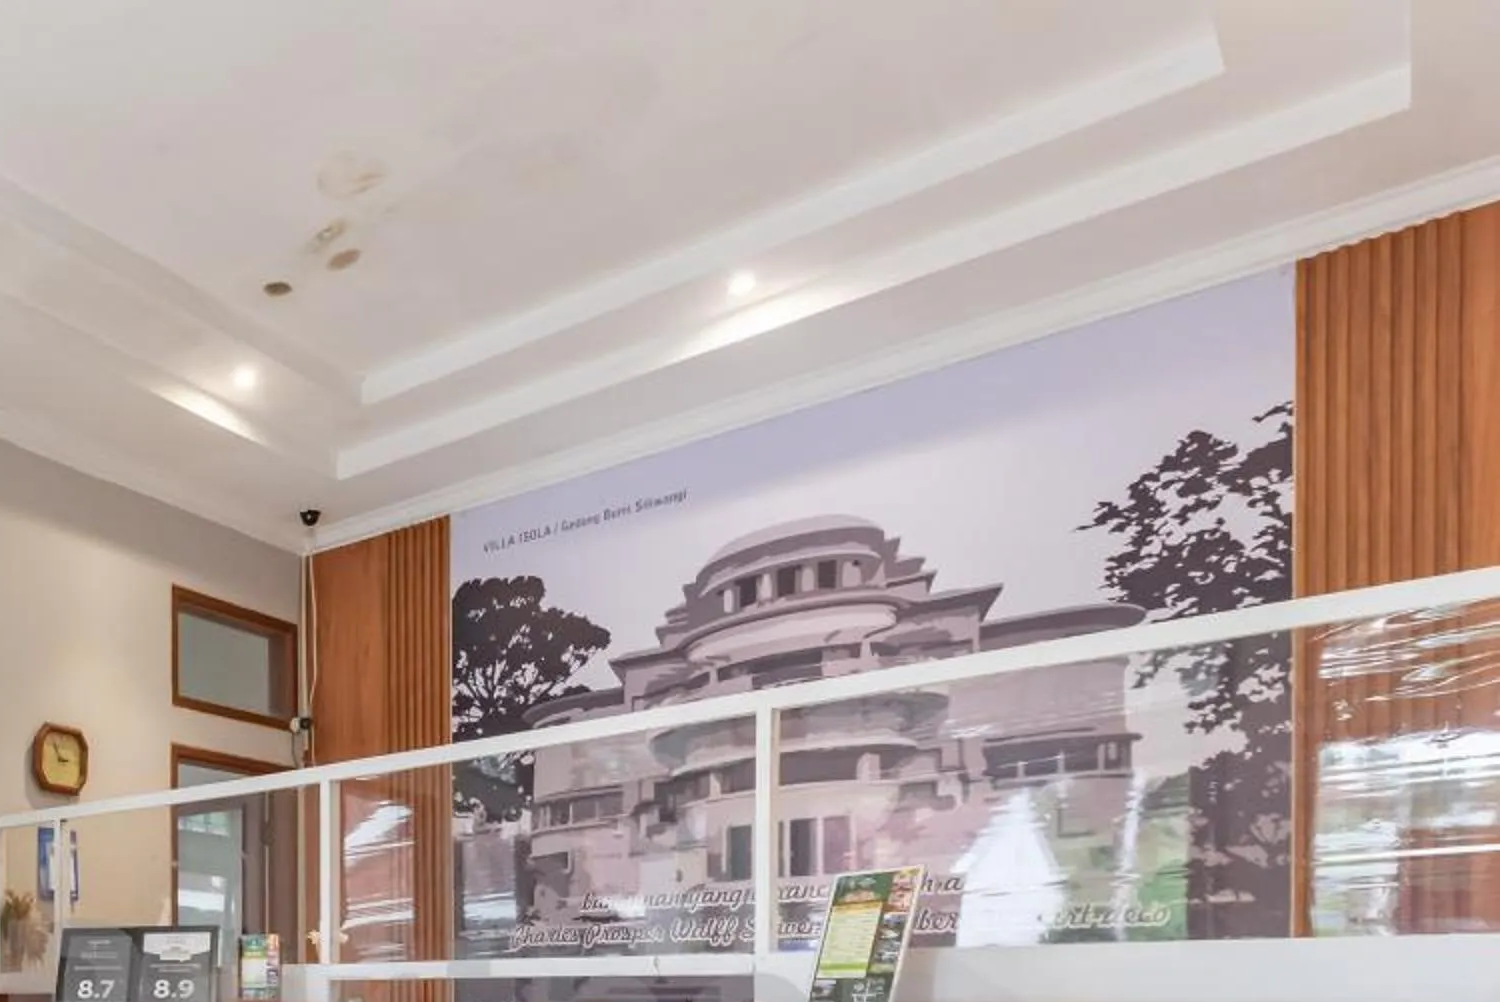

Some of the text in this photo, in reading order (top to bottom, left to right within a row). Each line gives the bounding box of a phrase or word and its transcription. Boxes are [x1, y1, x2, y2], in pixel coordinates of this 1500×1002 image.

[519, 526, 551, 544] ISOLA
[77, 979, 115, 999] 8.7
[153, 979, 195, 999] 8.9
